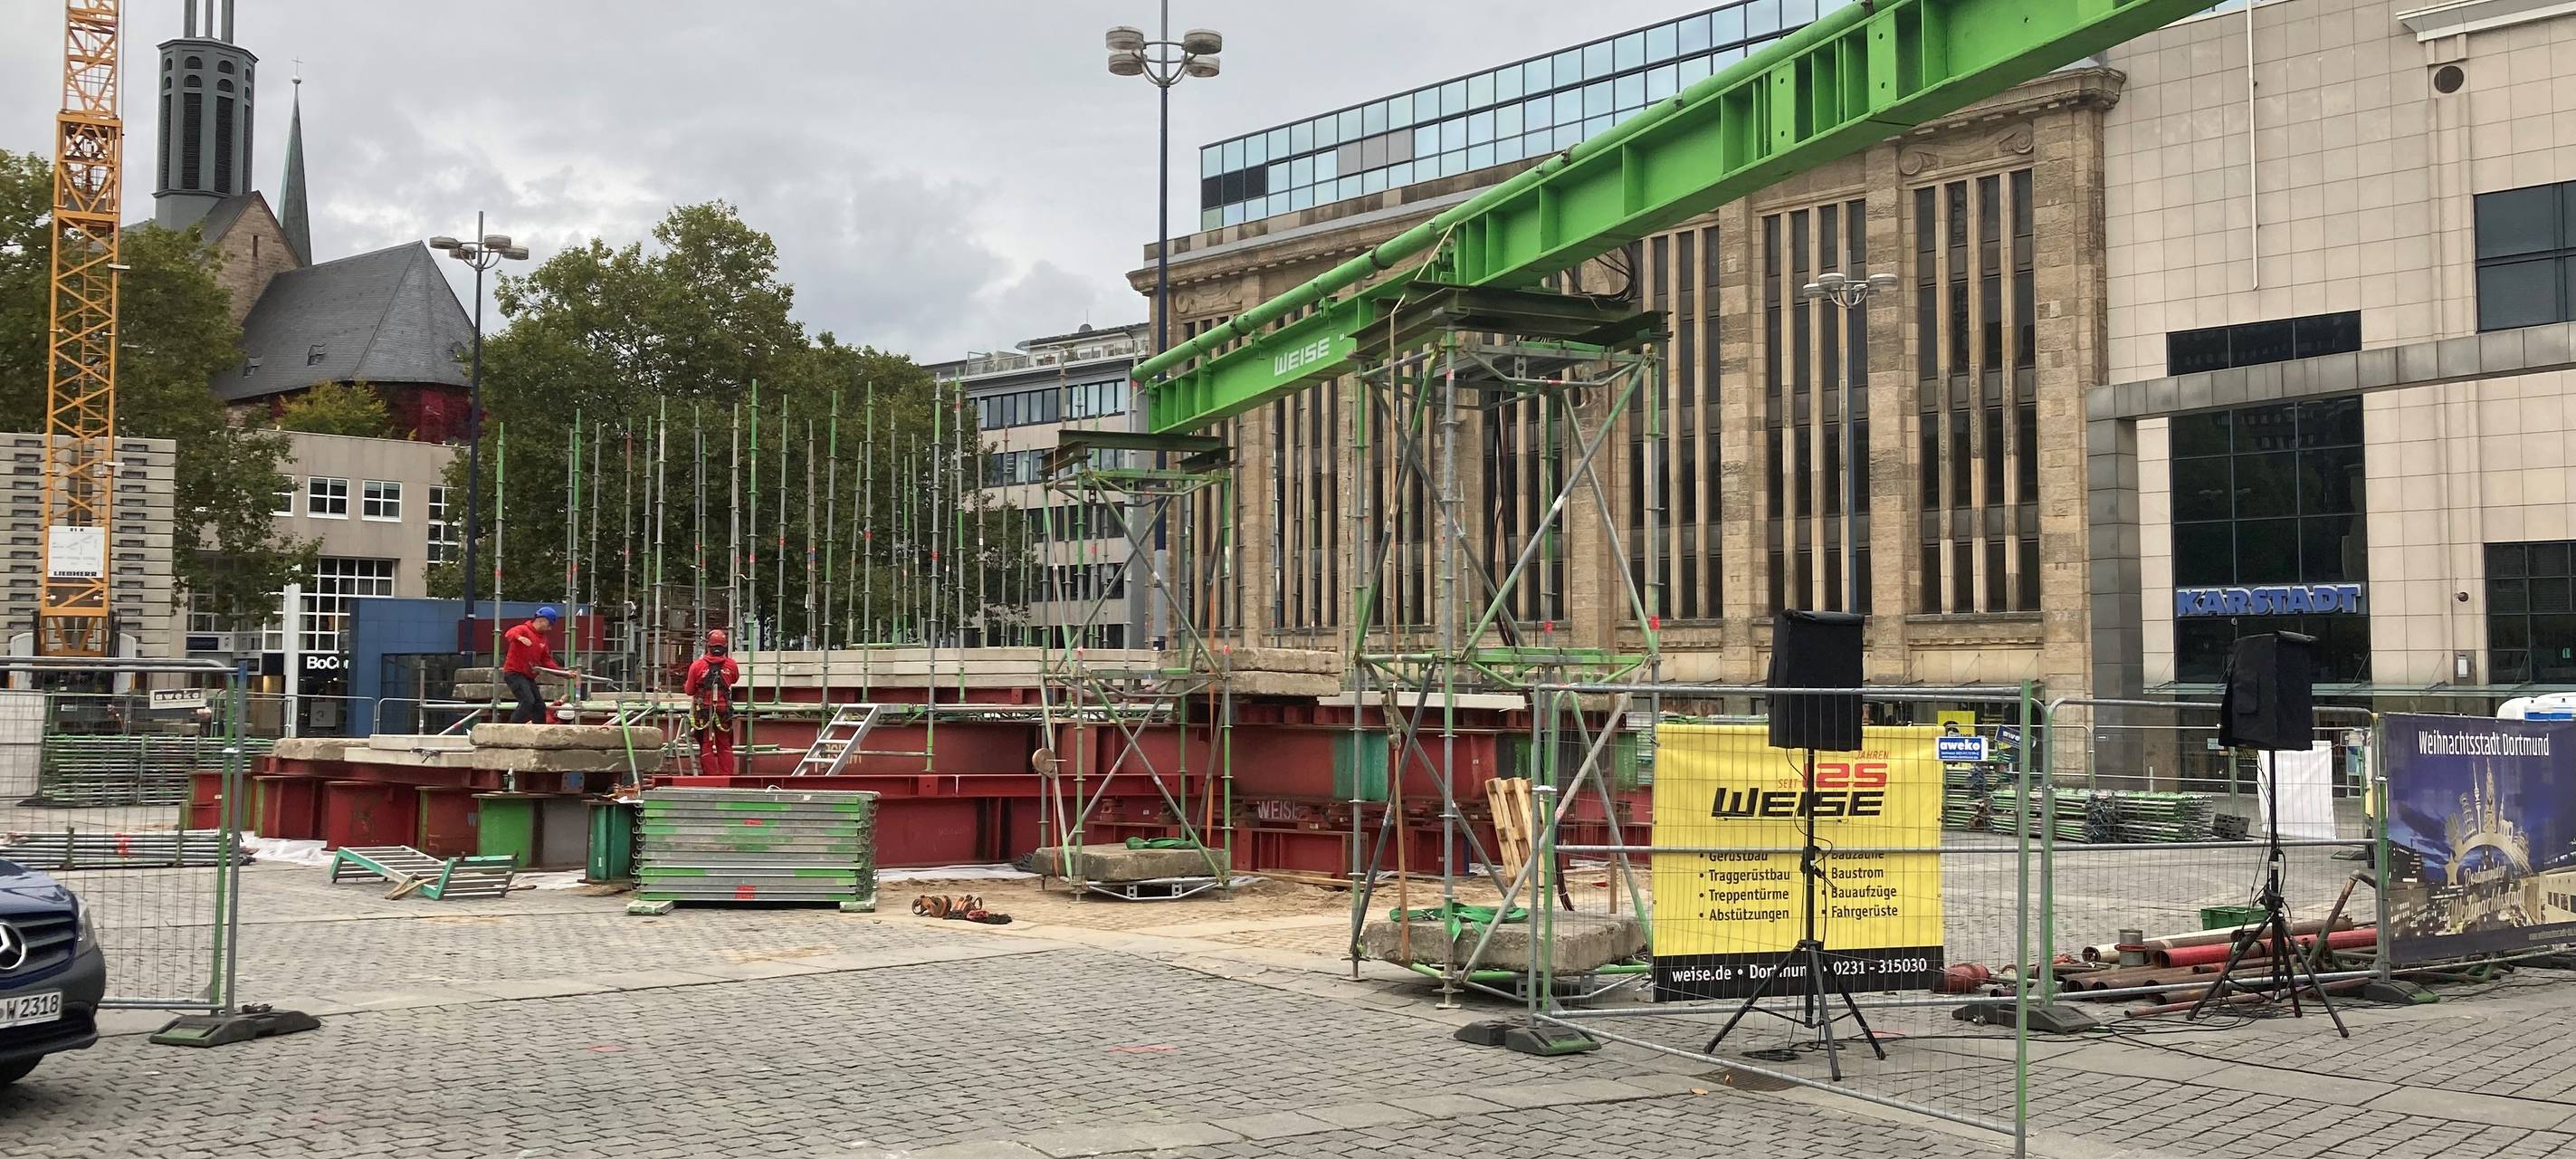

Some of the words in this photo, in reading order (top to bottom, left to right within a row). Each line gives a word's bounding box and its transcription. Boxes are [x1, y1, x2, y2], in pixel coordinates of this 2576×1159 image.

[1274, 337, 1331, 377] WEISE
[2176, 584, 2361, 617] KARSTADT
[306, 656, 349, 670] BoC
[155, 691, 199, 700] aweko
[1940, 739, 1980, 751] aweko
[2419, 730, 2501, 755] Weihnachtsstadt
[2502, 733, 2550, 756] Dortmund
[1856, 751, 1889, 760] JAHREN
[1778, 779, 1798, 789] SEIT
[1711, 787, 1884, 817] WEISE
[1709, 868, 1790, 882] Traggerüstbau
[1831, 867, 1884, 879] Baustrom
[1709, 888, 1789, 903] Treppentürme
[1831, 885, 1897, 900] Bauaufzüge
[1709, 908, 1789, 922] Abstützungen
[1831, 905, 1898, 920] Fahrgerüste
[1672, 965, 1732, 982] weise.de
[1749, 963, 1808, 979] Dormun
[1833, 960, 1865, 975] 0231
[1877, 957, 1928, 974] 315030
[6, 1000, 17, 1020] W
[19, 994, 60, 1019] 2318
